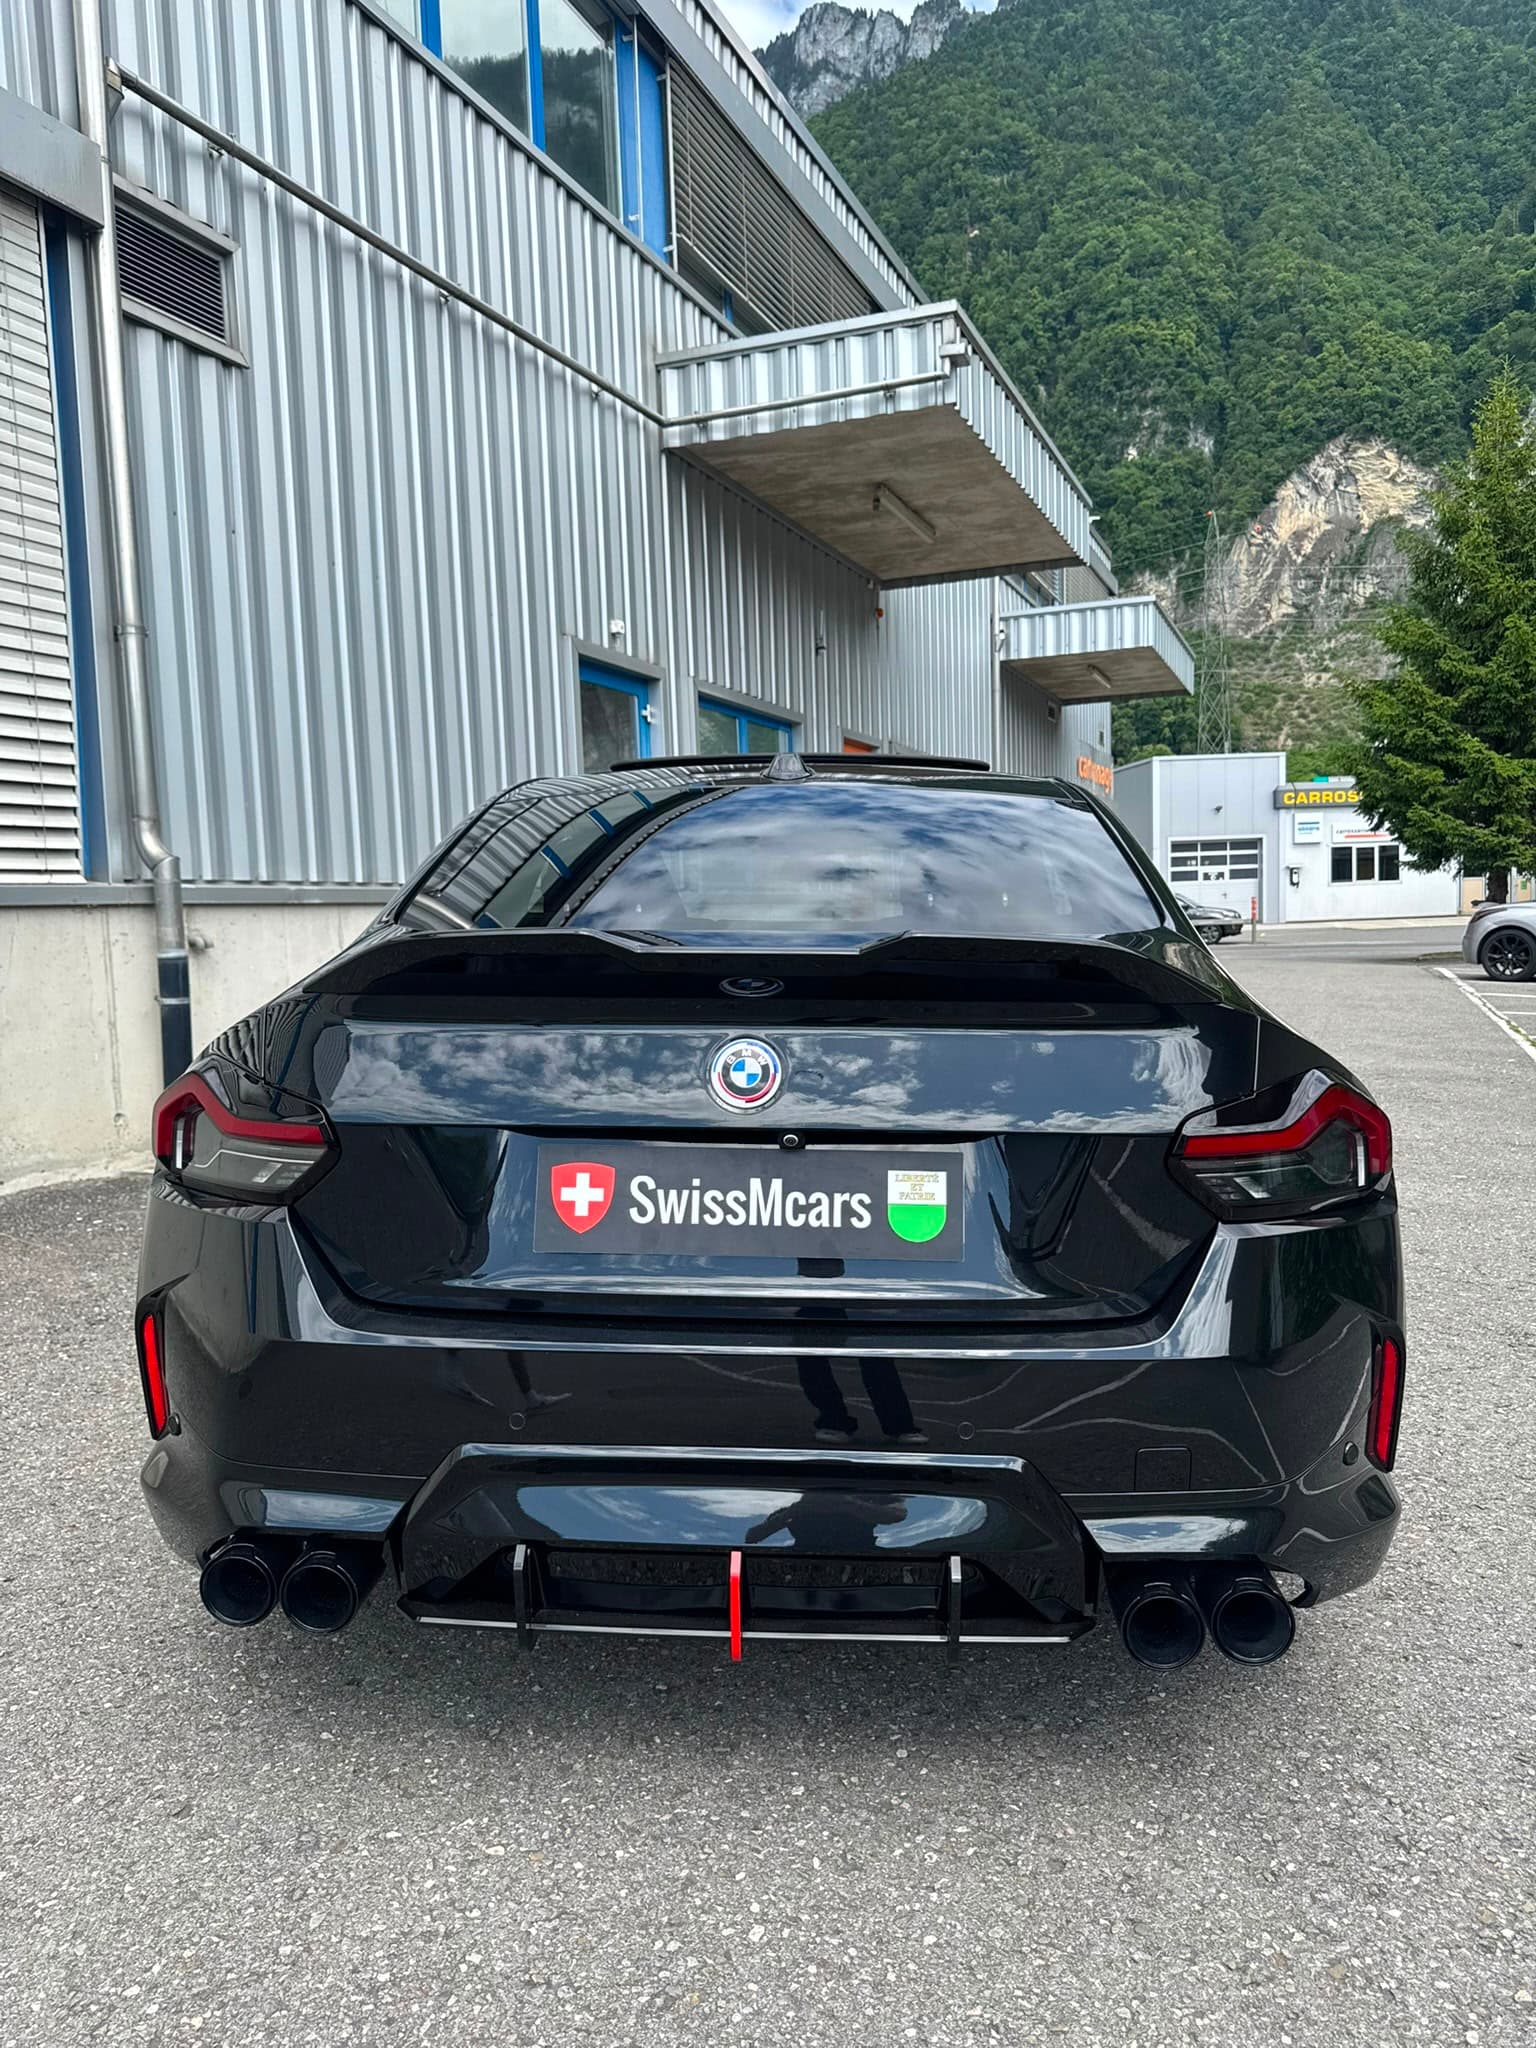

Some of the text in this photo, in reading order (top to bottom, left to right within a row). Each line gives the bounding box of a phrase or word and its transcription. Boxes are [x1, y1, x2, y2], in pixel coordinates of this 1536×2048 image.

[911, 1183, 925, 1192] ET
[899, 1191, 936, 1201] PATRIE
[629, 1175, 872, 1229] SwissMcars
